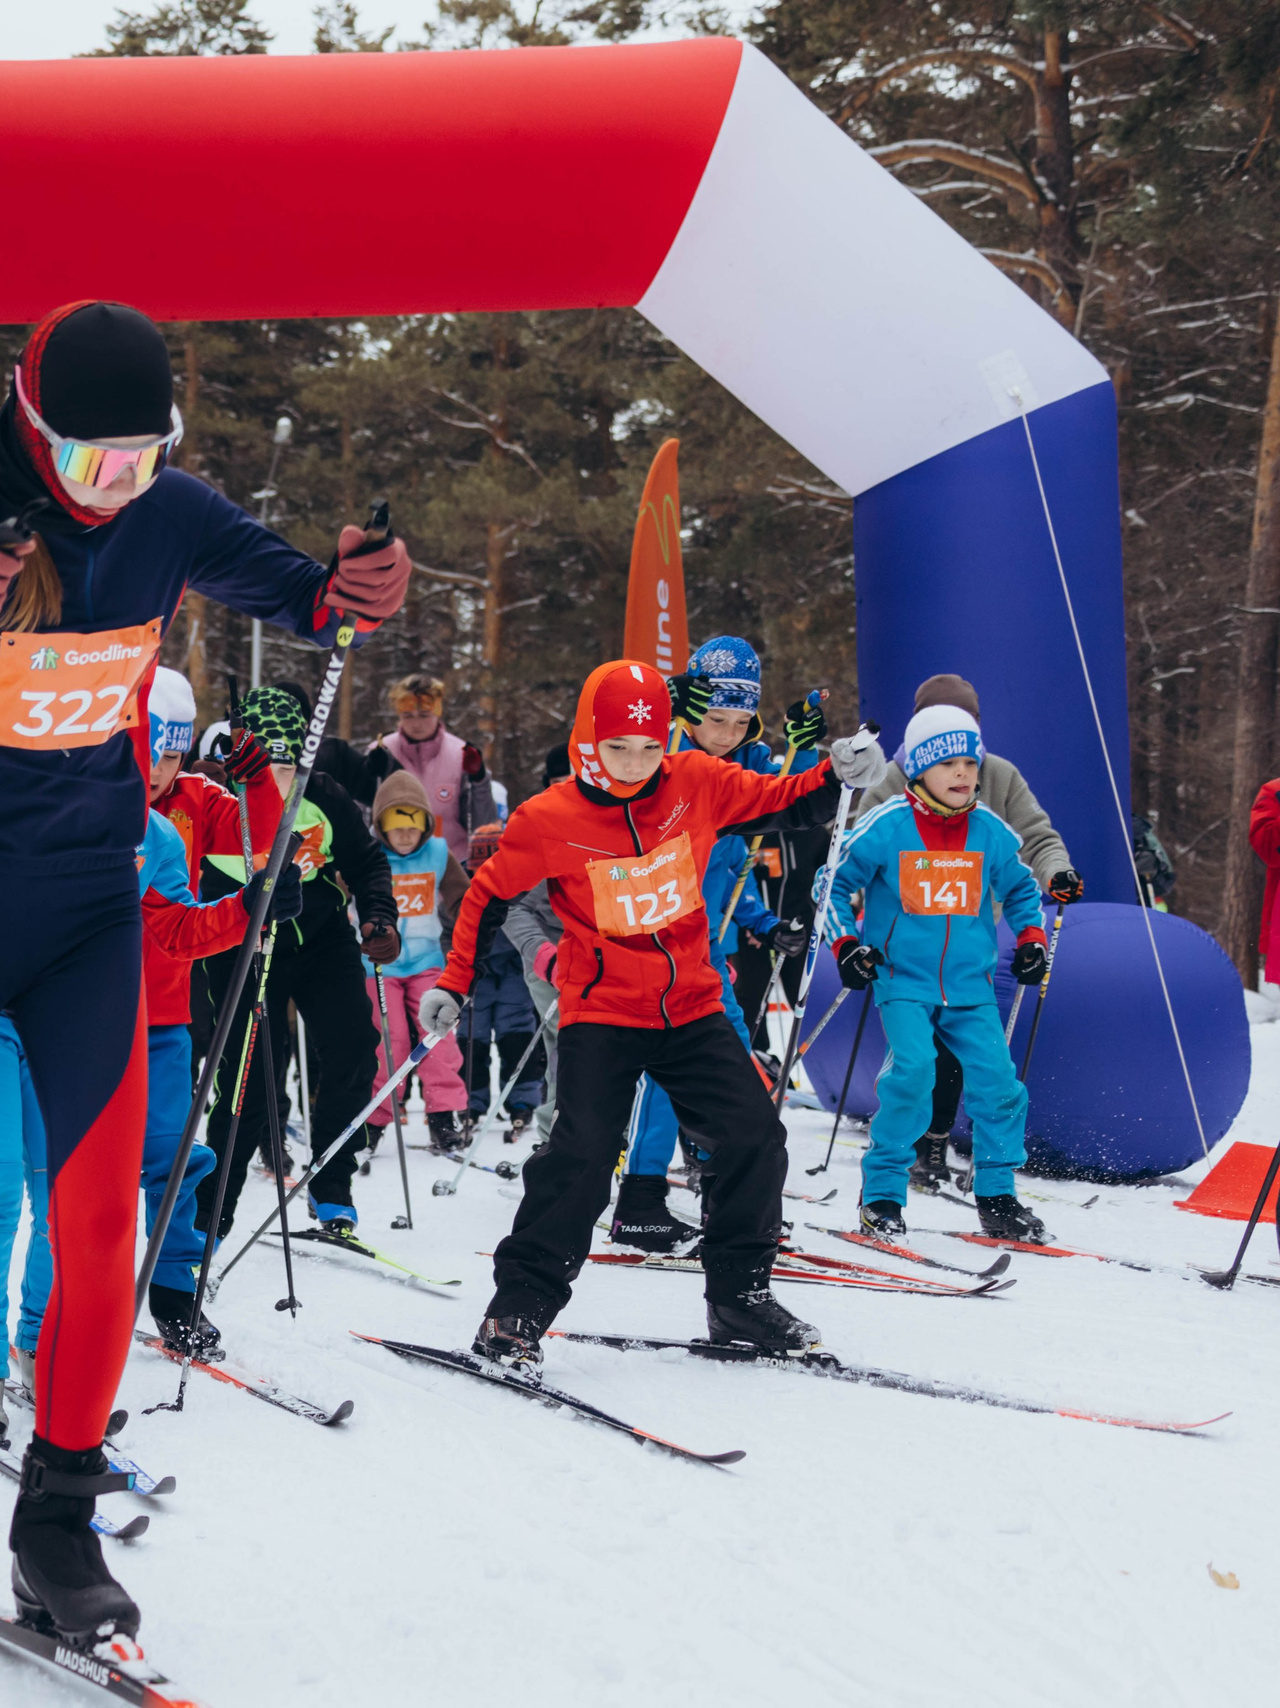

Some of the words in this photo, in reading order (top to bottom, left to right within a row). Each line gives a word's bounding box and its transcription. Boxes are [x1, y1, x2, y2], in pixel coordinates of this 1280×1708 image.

[64, 644, 142, 666] Goodline
[12, 685, 129, 737] 322
[299, 652, 345, 768] NORDWAY
[915, 732, 969, 760] ЛЫЖНЯ
[917, 743, 969, 770] РОССИИ
[631, 851, 677, 878] Goodline
[932, 858, 974, 868] Goodline
[616, 879, 682, 927] 123
[918, 881, 967, 908] 141
[621, 1225, 642, 1233] TARA
[643, 1225, 673, 1233] SPORT
[54, 1645, 111, 1687] MADSHUS
